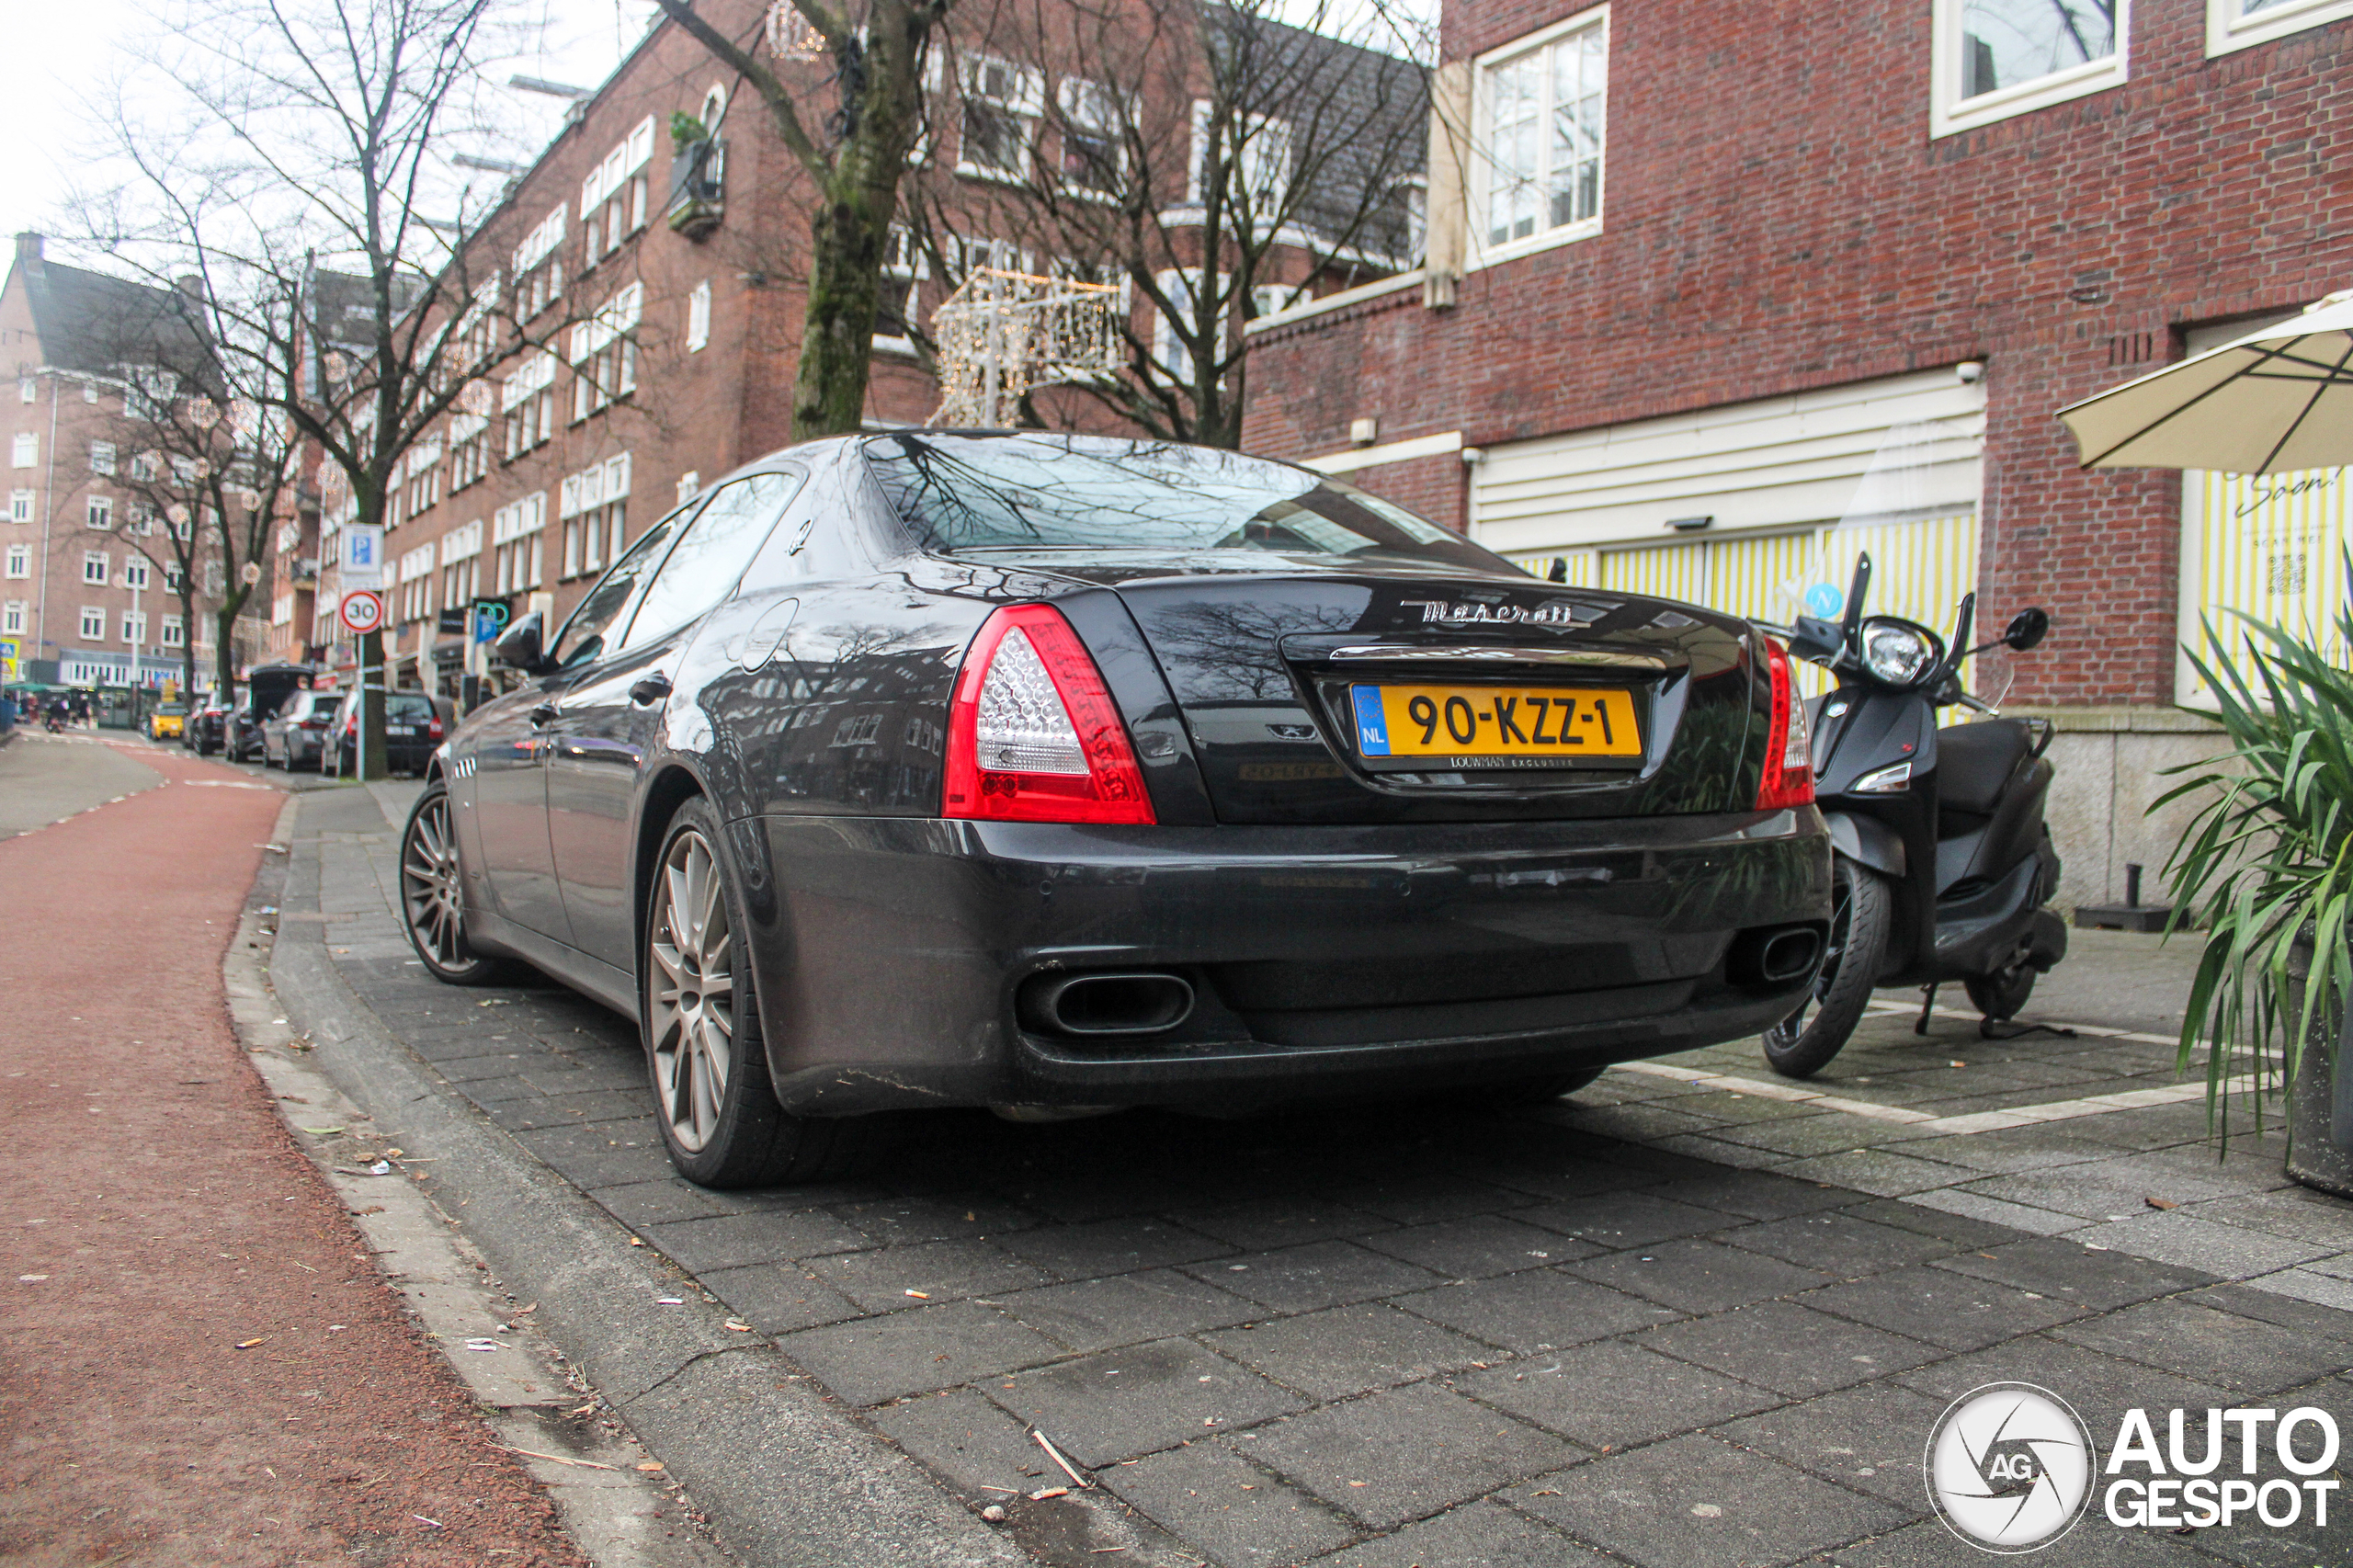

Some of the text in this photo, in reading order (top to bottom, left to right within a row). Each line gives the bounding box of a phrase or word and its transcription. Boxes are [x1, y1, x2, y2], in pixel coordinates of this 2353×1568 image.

[348, 603, 374, 619] 30
[1401, 600, 1591, 628] Maserati
[1408, 696, 1613, 745] 90-KZZ-1
[1362, 727, 1385, 744] NL
[1450, 757, 1574, 768] LOUWMAN EXCLUSIVE
